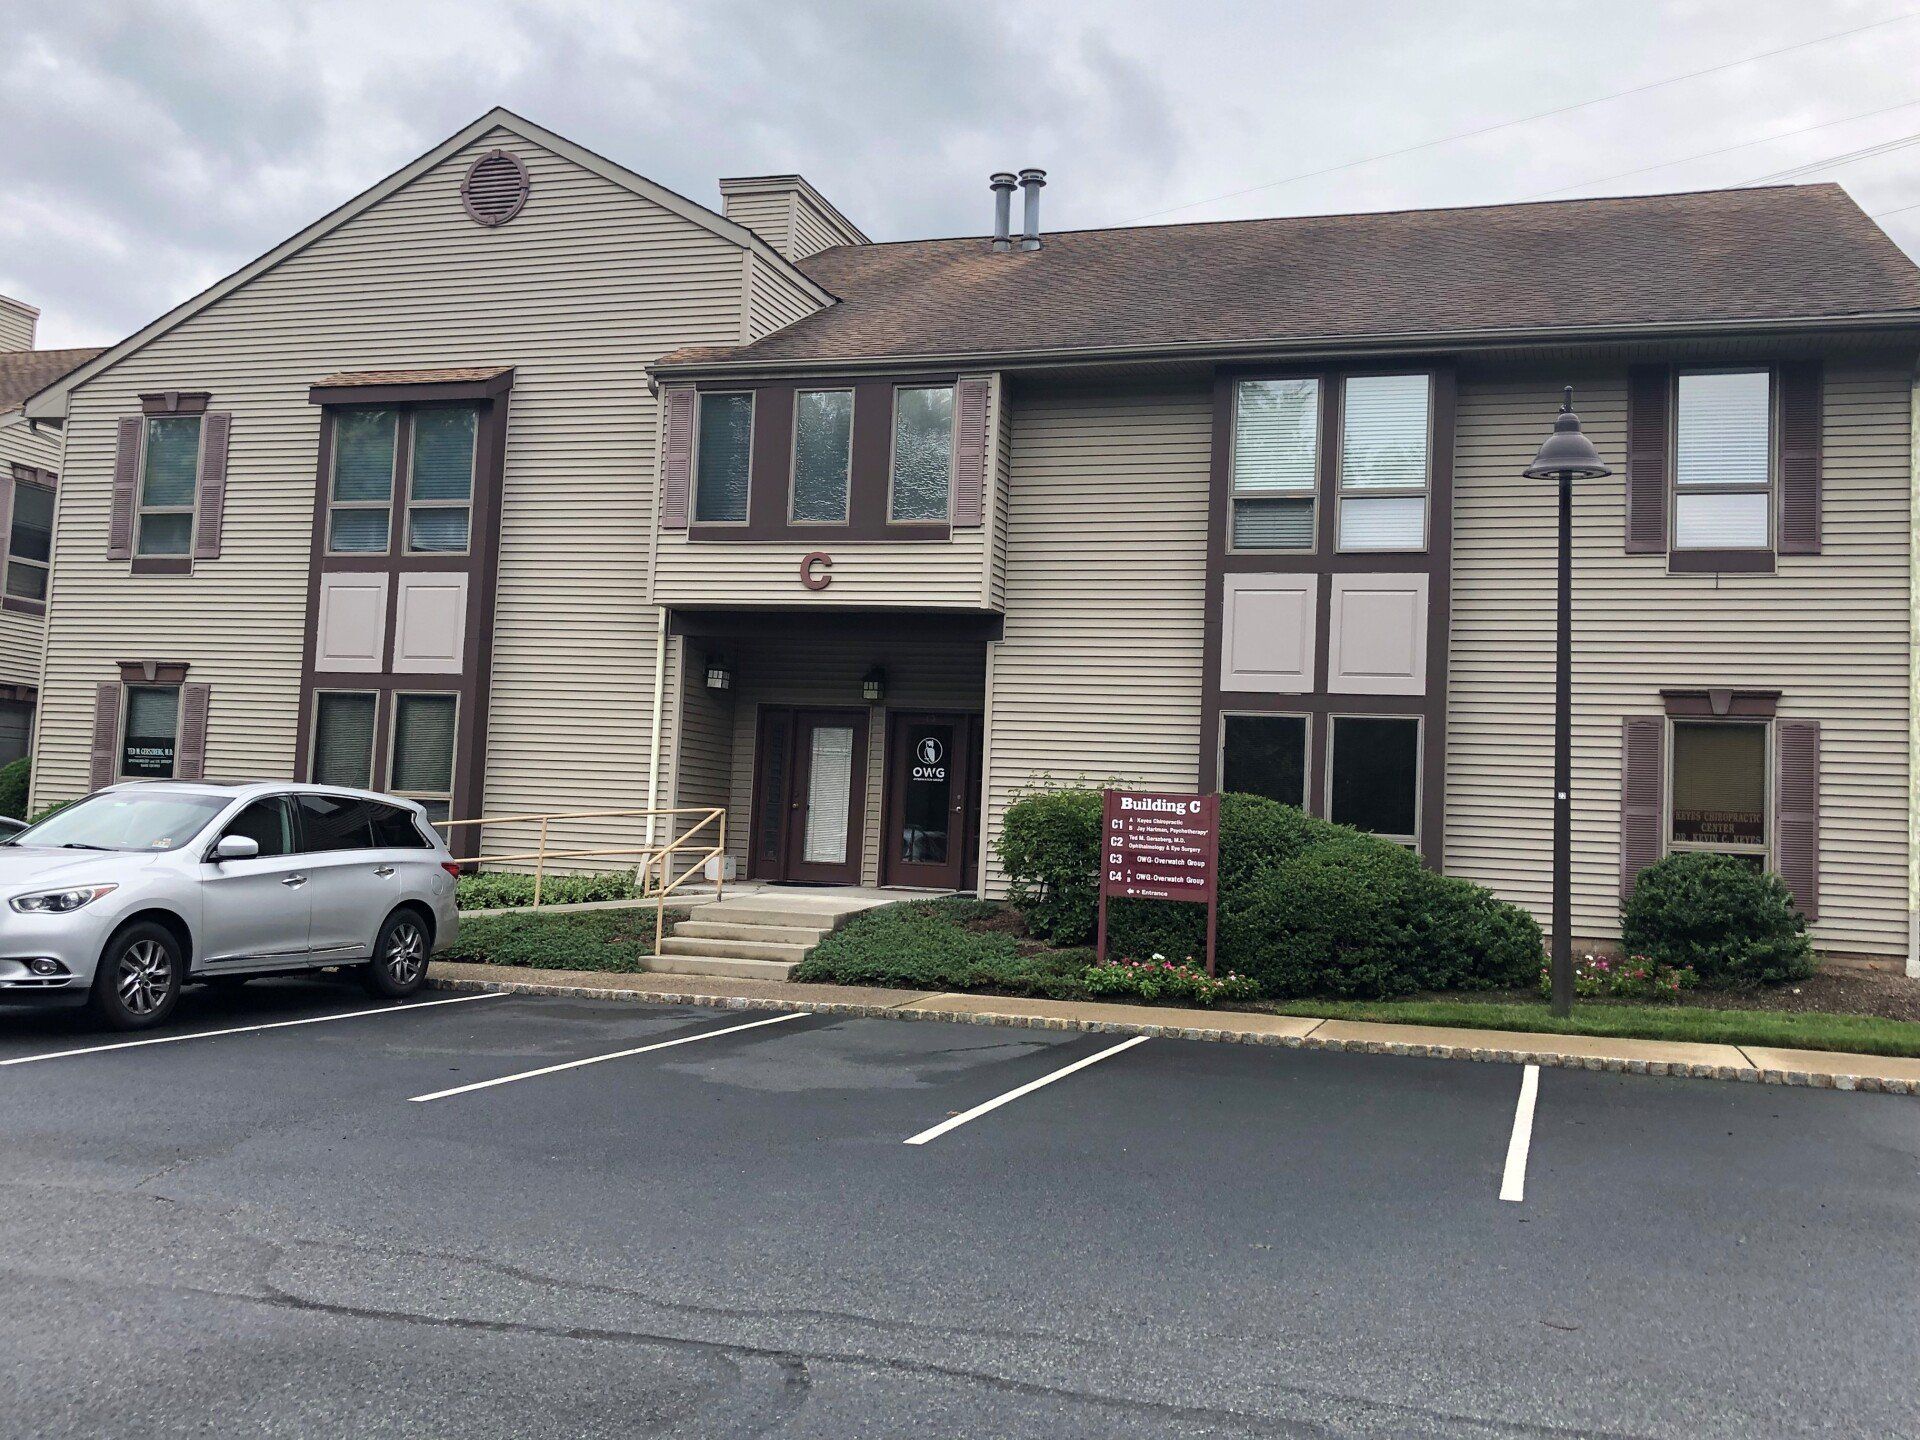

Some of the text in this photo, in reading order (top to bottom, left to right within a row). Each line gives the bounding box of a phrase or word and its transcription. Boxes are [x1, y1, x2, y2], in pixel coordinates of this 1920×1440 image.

[800, 551, 832, 590] C
[912, 767, 945, 778] OWG
[1121, 797, 1201, 815] Building C
[1111, 819, 1123, 829] C1
[1137, 817, 1152, 825] Keyes
[1153, 818, 1183, 826] Chiropractic
[1701, 822, 1735, 834] CENTER
[1110, 836, 1123, 847] C2
[1129, 842, 1165, 851] Ophthalmology
[1181, 846, 1201, 854] Surgery
[1109, 853, 1123, 864] C3
[1187, 859, 1206, 868] Group
[1109, 870, 1122, 881] C4
[1186, 876, 1204, 886] Group
[1141, 889, 1168, 897] Entrance
